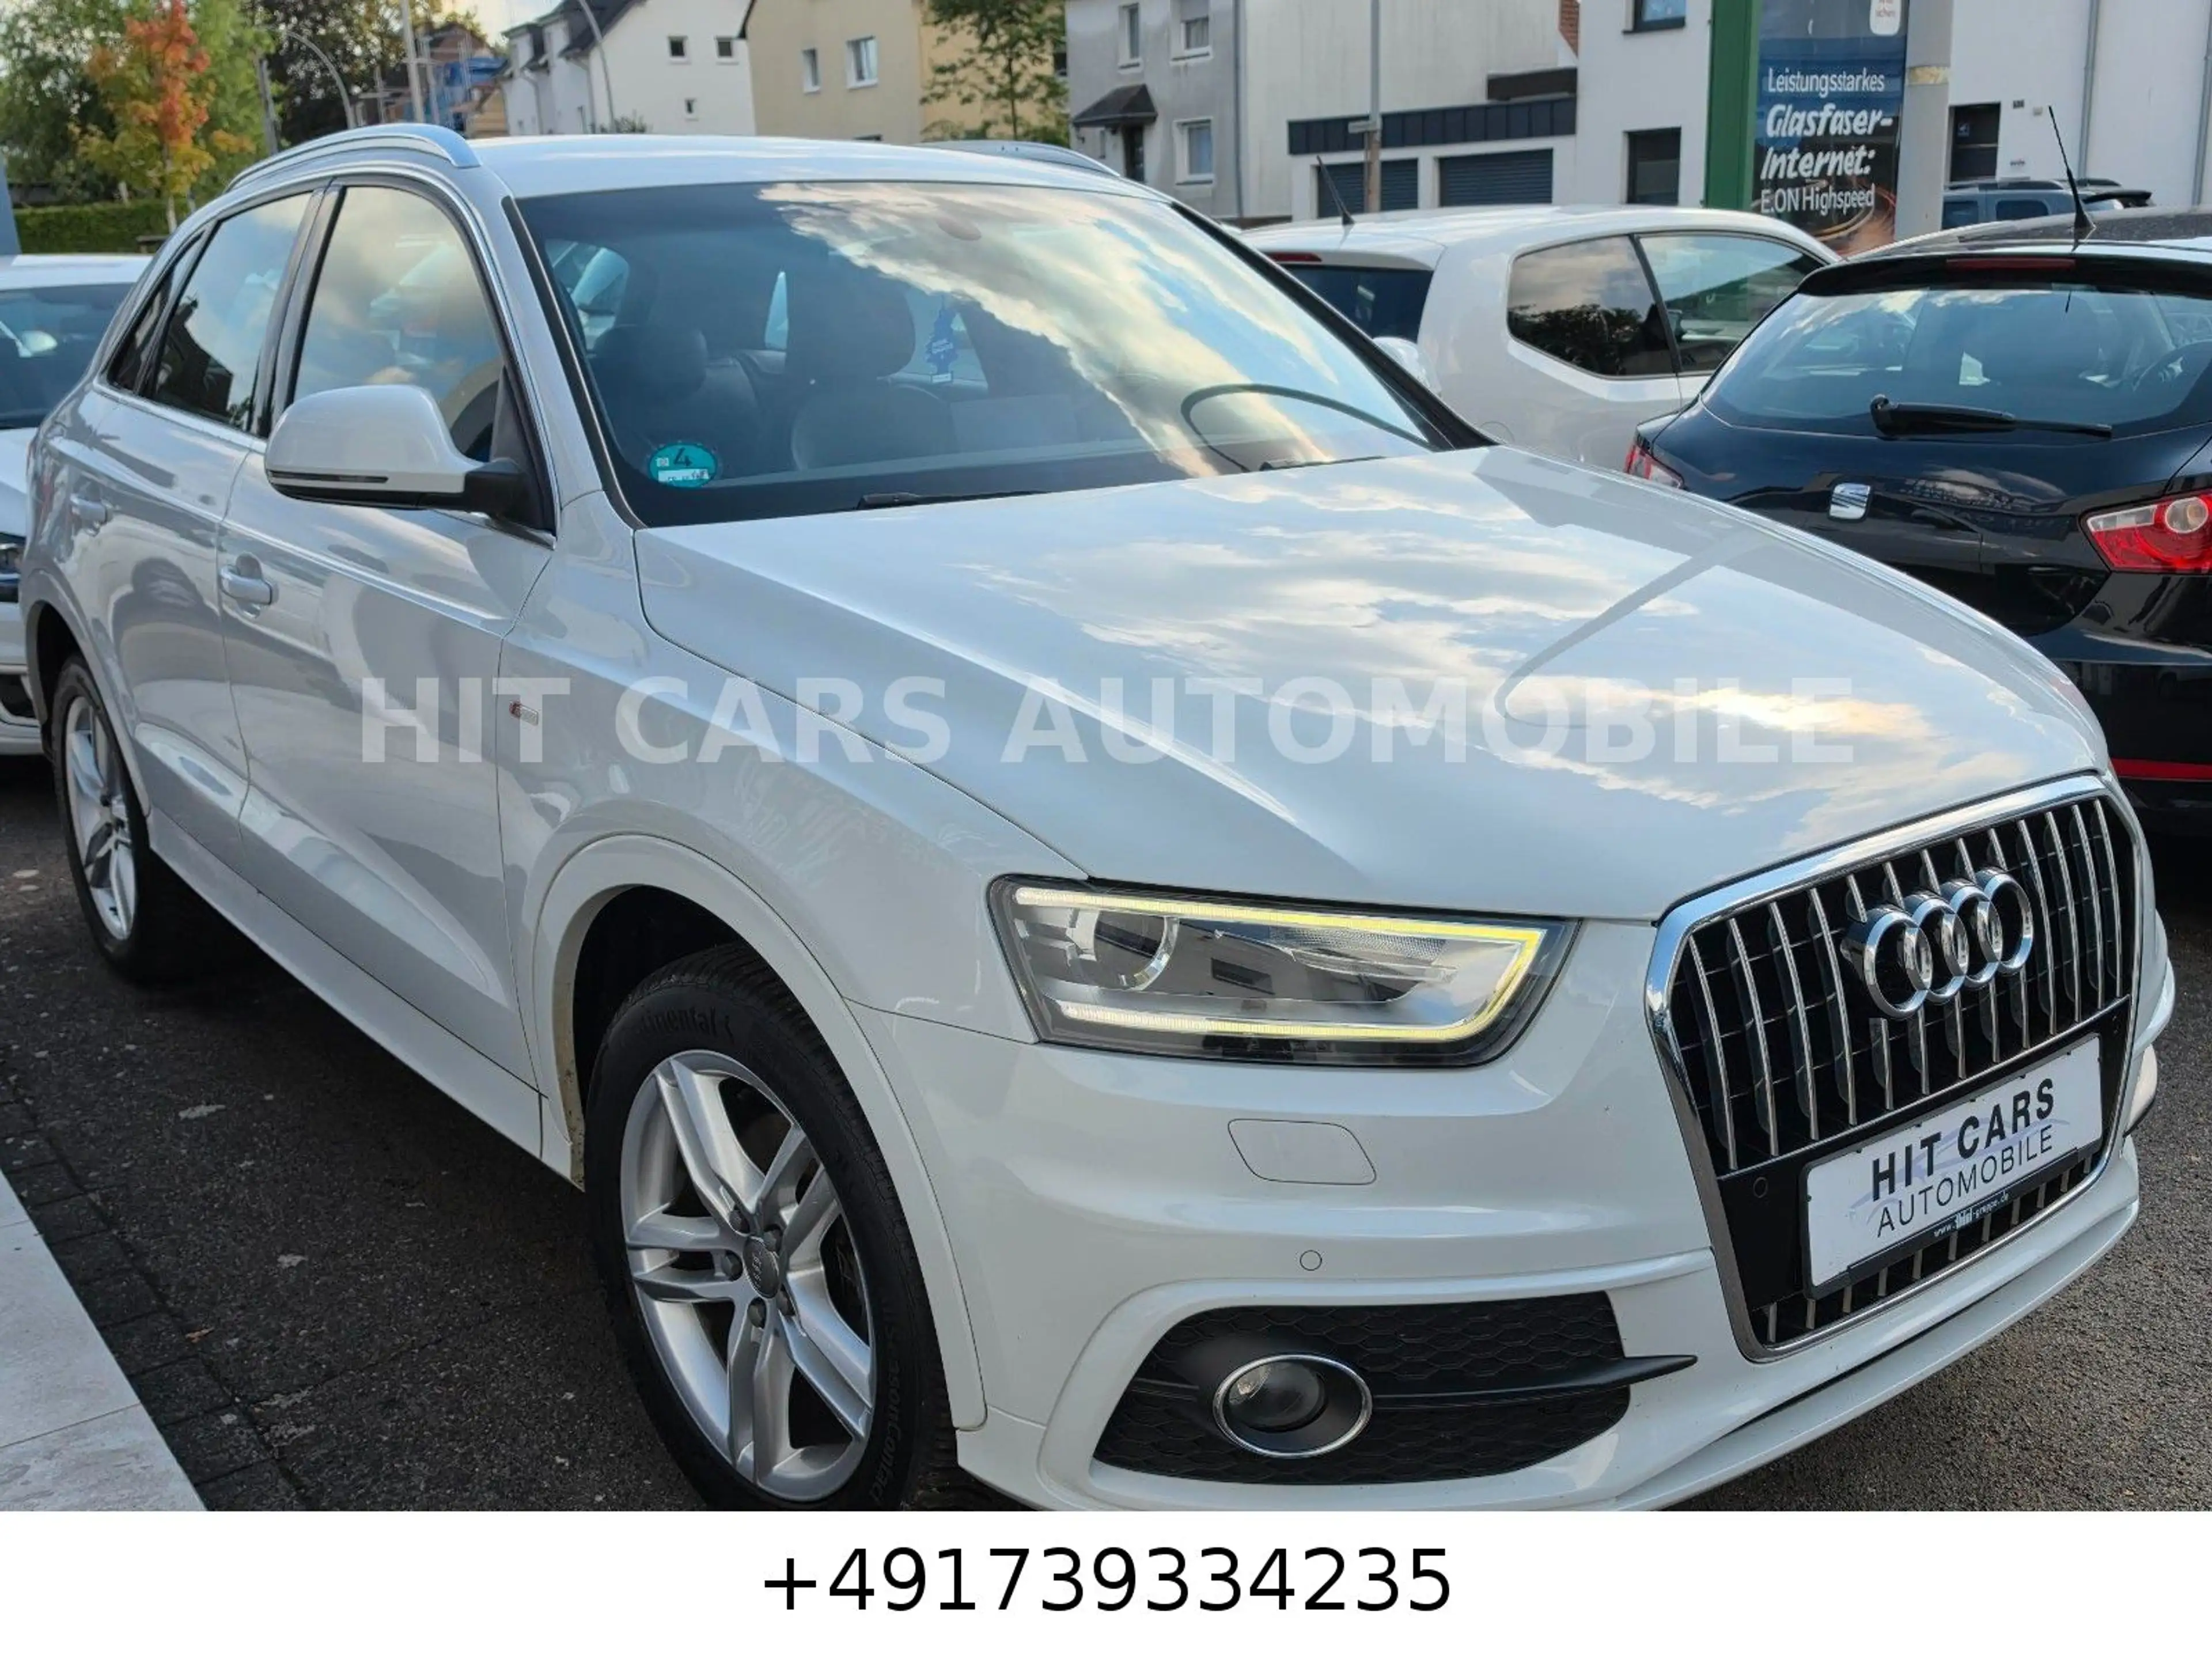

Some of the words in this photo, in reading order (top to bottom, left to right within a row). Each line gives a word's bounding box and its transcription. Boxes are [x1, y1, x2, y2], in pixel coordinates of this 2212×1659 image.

[1768, 67, 1885, 98] Leistungsstarkes
[1766, 103, 1893, 138] Glasfaser-
[1760, 144, 1876, 180] Internet:
[1761, 187, 1799, 214] E.ON
[1802, 182, 1876, 215] Highspeed
[673, 447, 692, 467] 4
[1873, 1131, 1941, 1201] HIT
[1957, 1078, 2054, 1159] CARS
[1877, 1124, 2052, 1238] AUTOMOBILE
